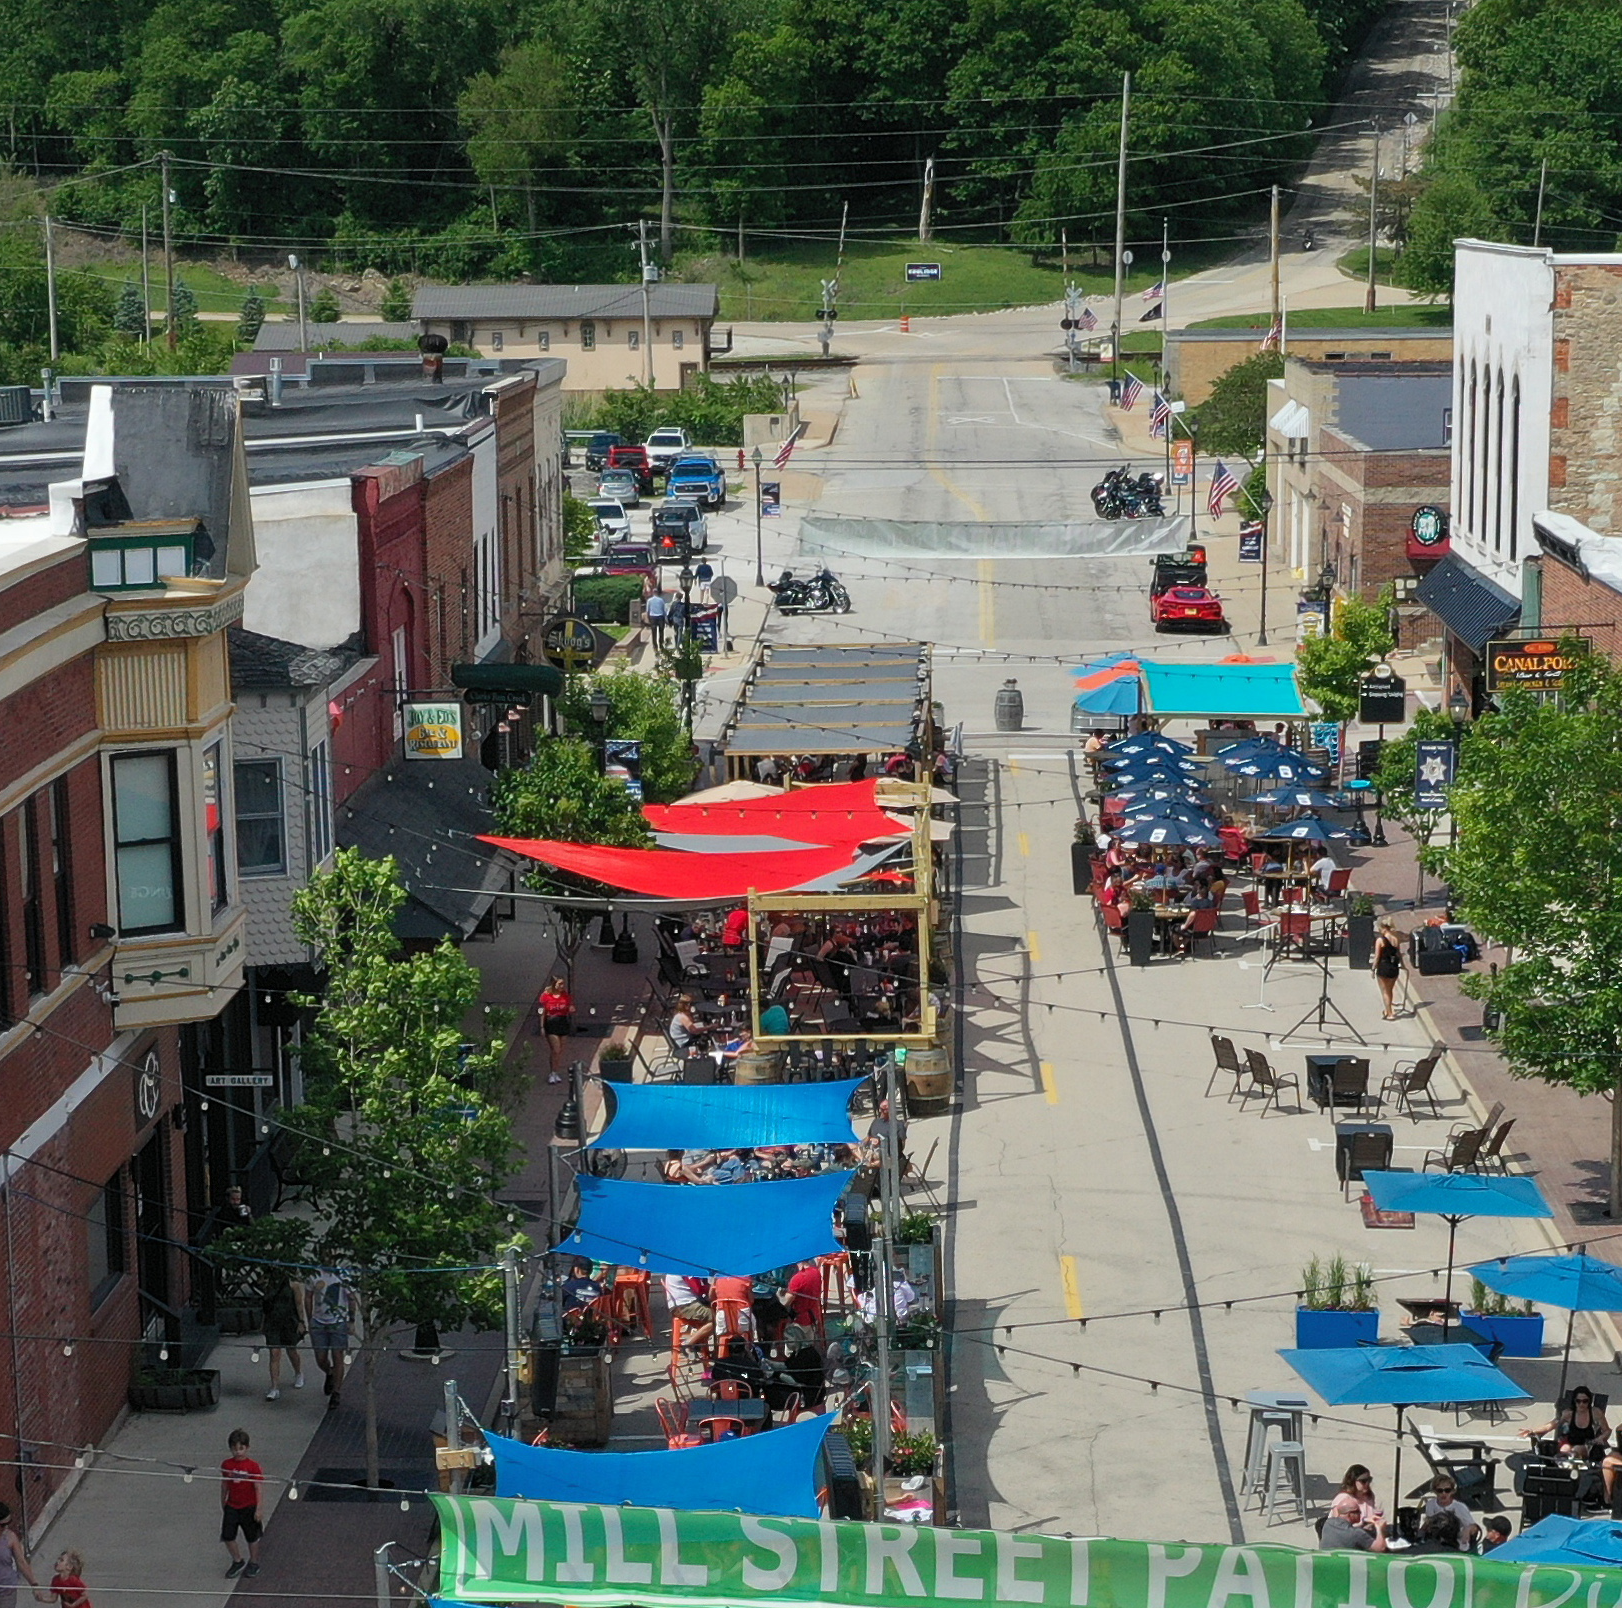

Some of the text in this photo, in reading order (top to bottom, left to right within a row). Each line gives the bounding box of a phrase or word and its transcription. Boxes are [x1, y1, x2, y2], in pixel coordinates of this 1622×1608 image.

[1494, 656, 1542, 672] CANAL
[210, 1077, 269, 1085] ART GALLERY
[469, 1499, 708, 1588] MILL
[740, 1512, 1107, 1606] STREET
